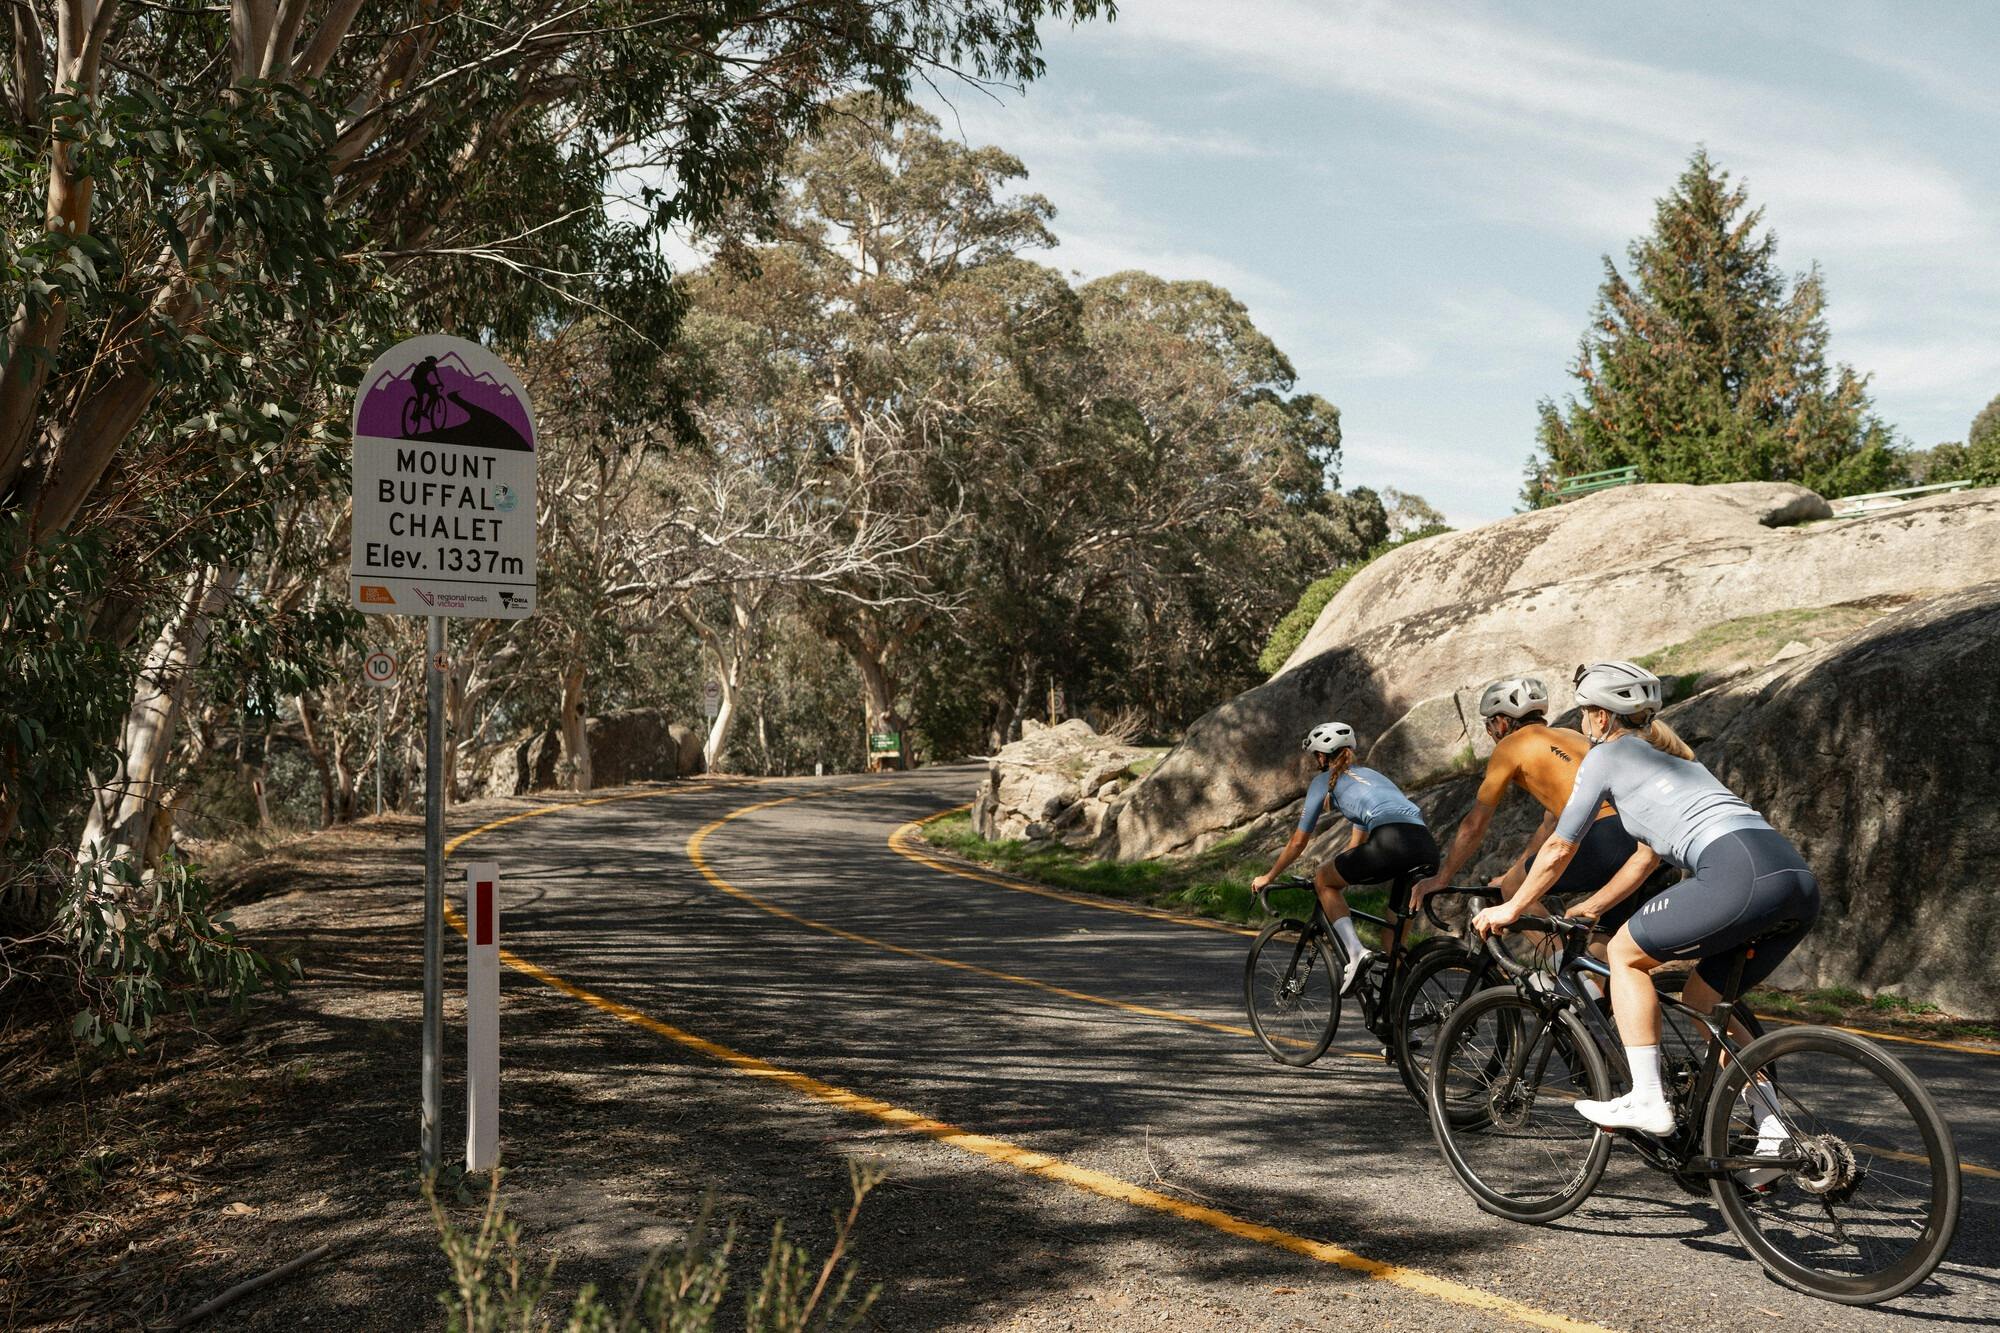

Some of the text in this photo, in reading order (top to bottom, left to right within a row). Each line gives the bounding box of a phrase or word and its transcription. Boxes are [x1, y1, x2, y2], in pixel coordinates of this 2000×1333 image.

[397, 448, 496, 479] MOUNT
[378, 479, 513, 511] BUFFAL
[389, 512, 503, 543] CHALET
[366, 542, 523, 575] Elev. 1337m
[437, 594, 467, 602] regional
[437, 600, 465, 608] victoria
[373, 660, 388, 674] 10
[1643, 898, 1669, 916] MAAP
